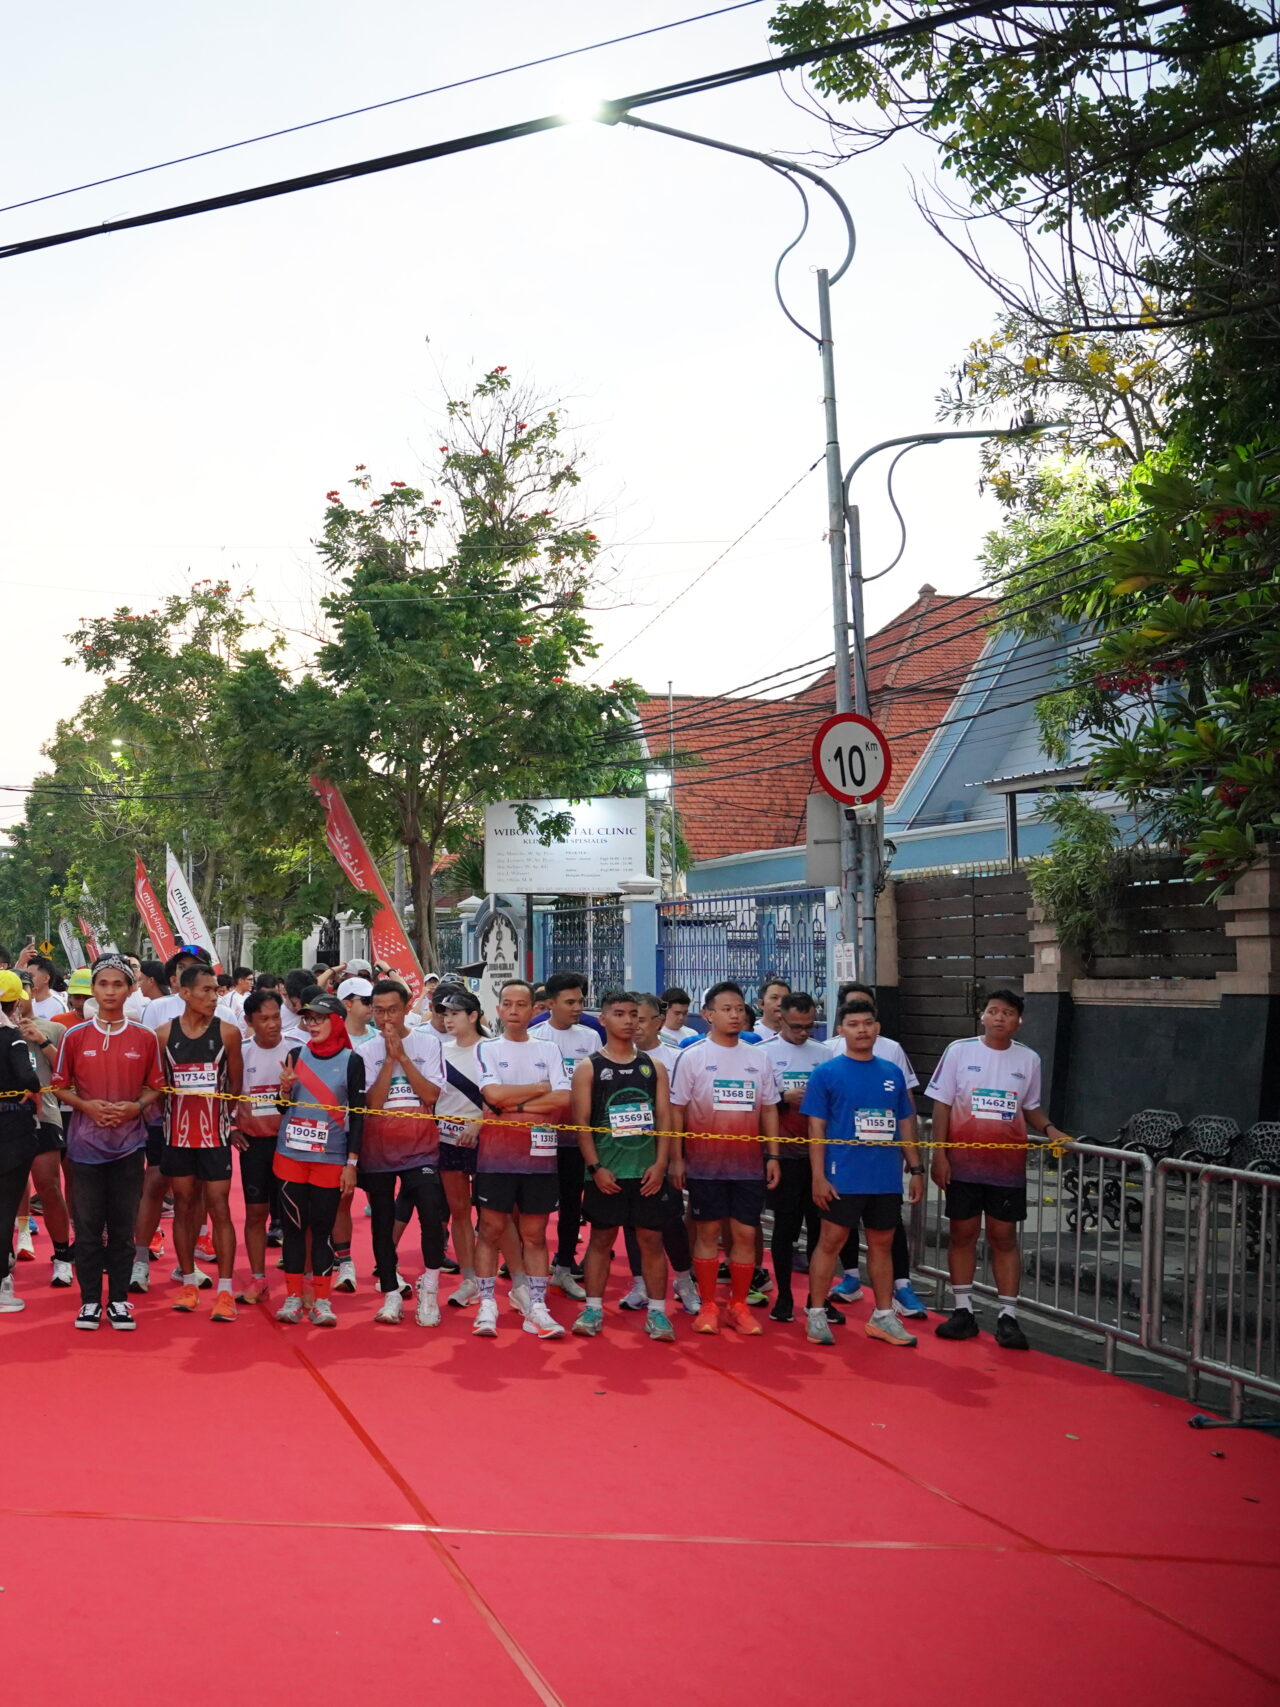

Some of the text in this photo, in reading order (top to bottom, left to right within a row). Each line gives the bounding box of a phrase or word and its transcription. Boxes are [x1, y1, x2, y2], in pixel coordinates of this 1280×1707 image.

[865, 742, 878, 751] Km
[834, 745, 866, 787] 10
[597, 827, 637, 836] CLINIC
[471, 979, 478, 989] P
[181, 1072, 206, 1081] 1734
[722, 1089, 744, 1098] 1368
[981, 1098, 1005, 1107] 1462
[618, 1113, 642, 1122] 3569
[865, 1119, 885, 1127] 1155
[292, 1127, 316, 1138] 1905
[540, 1134, 554, 1142] 1315
